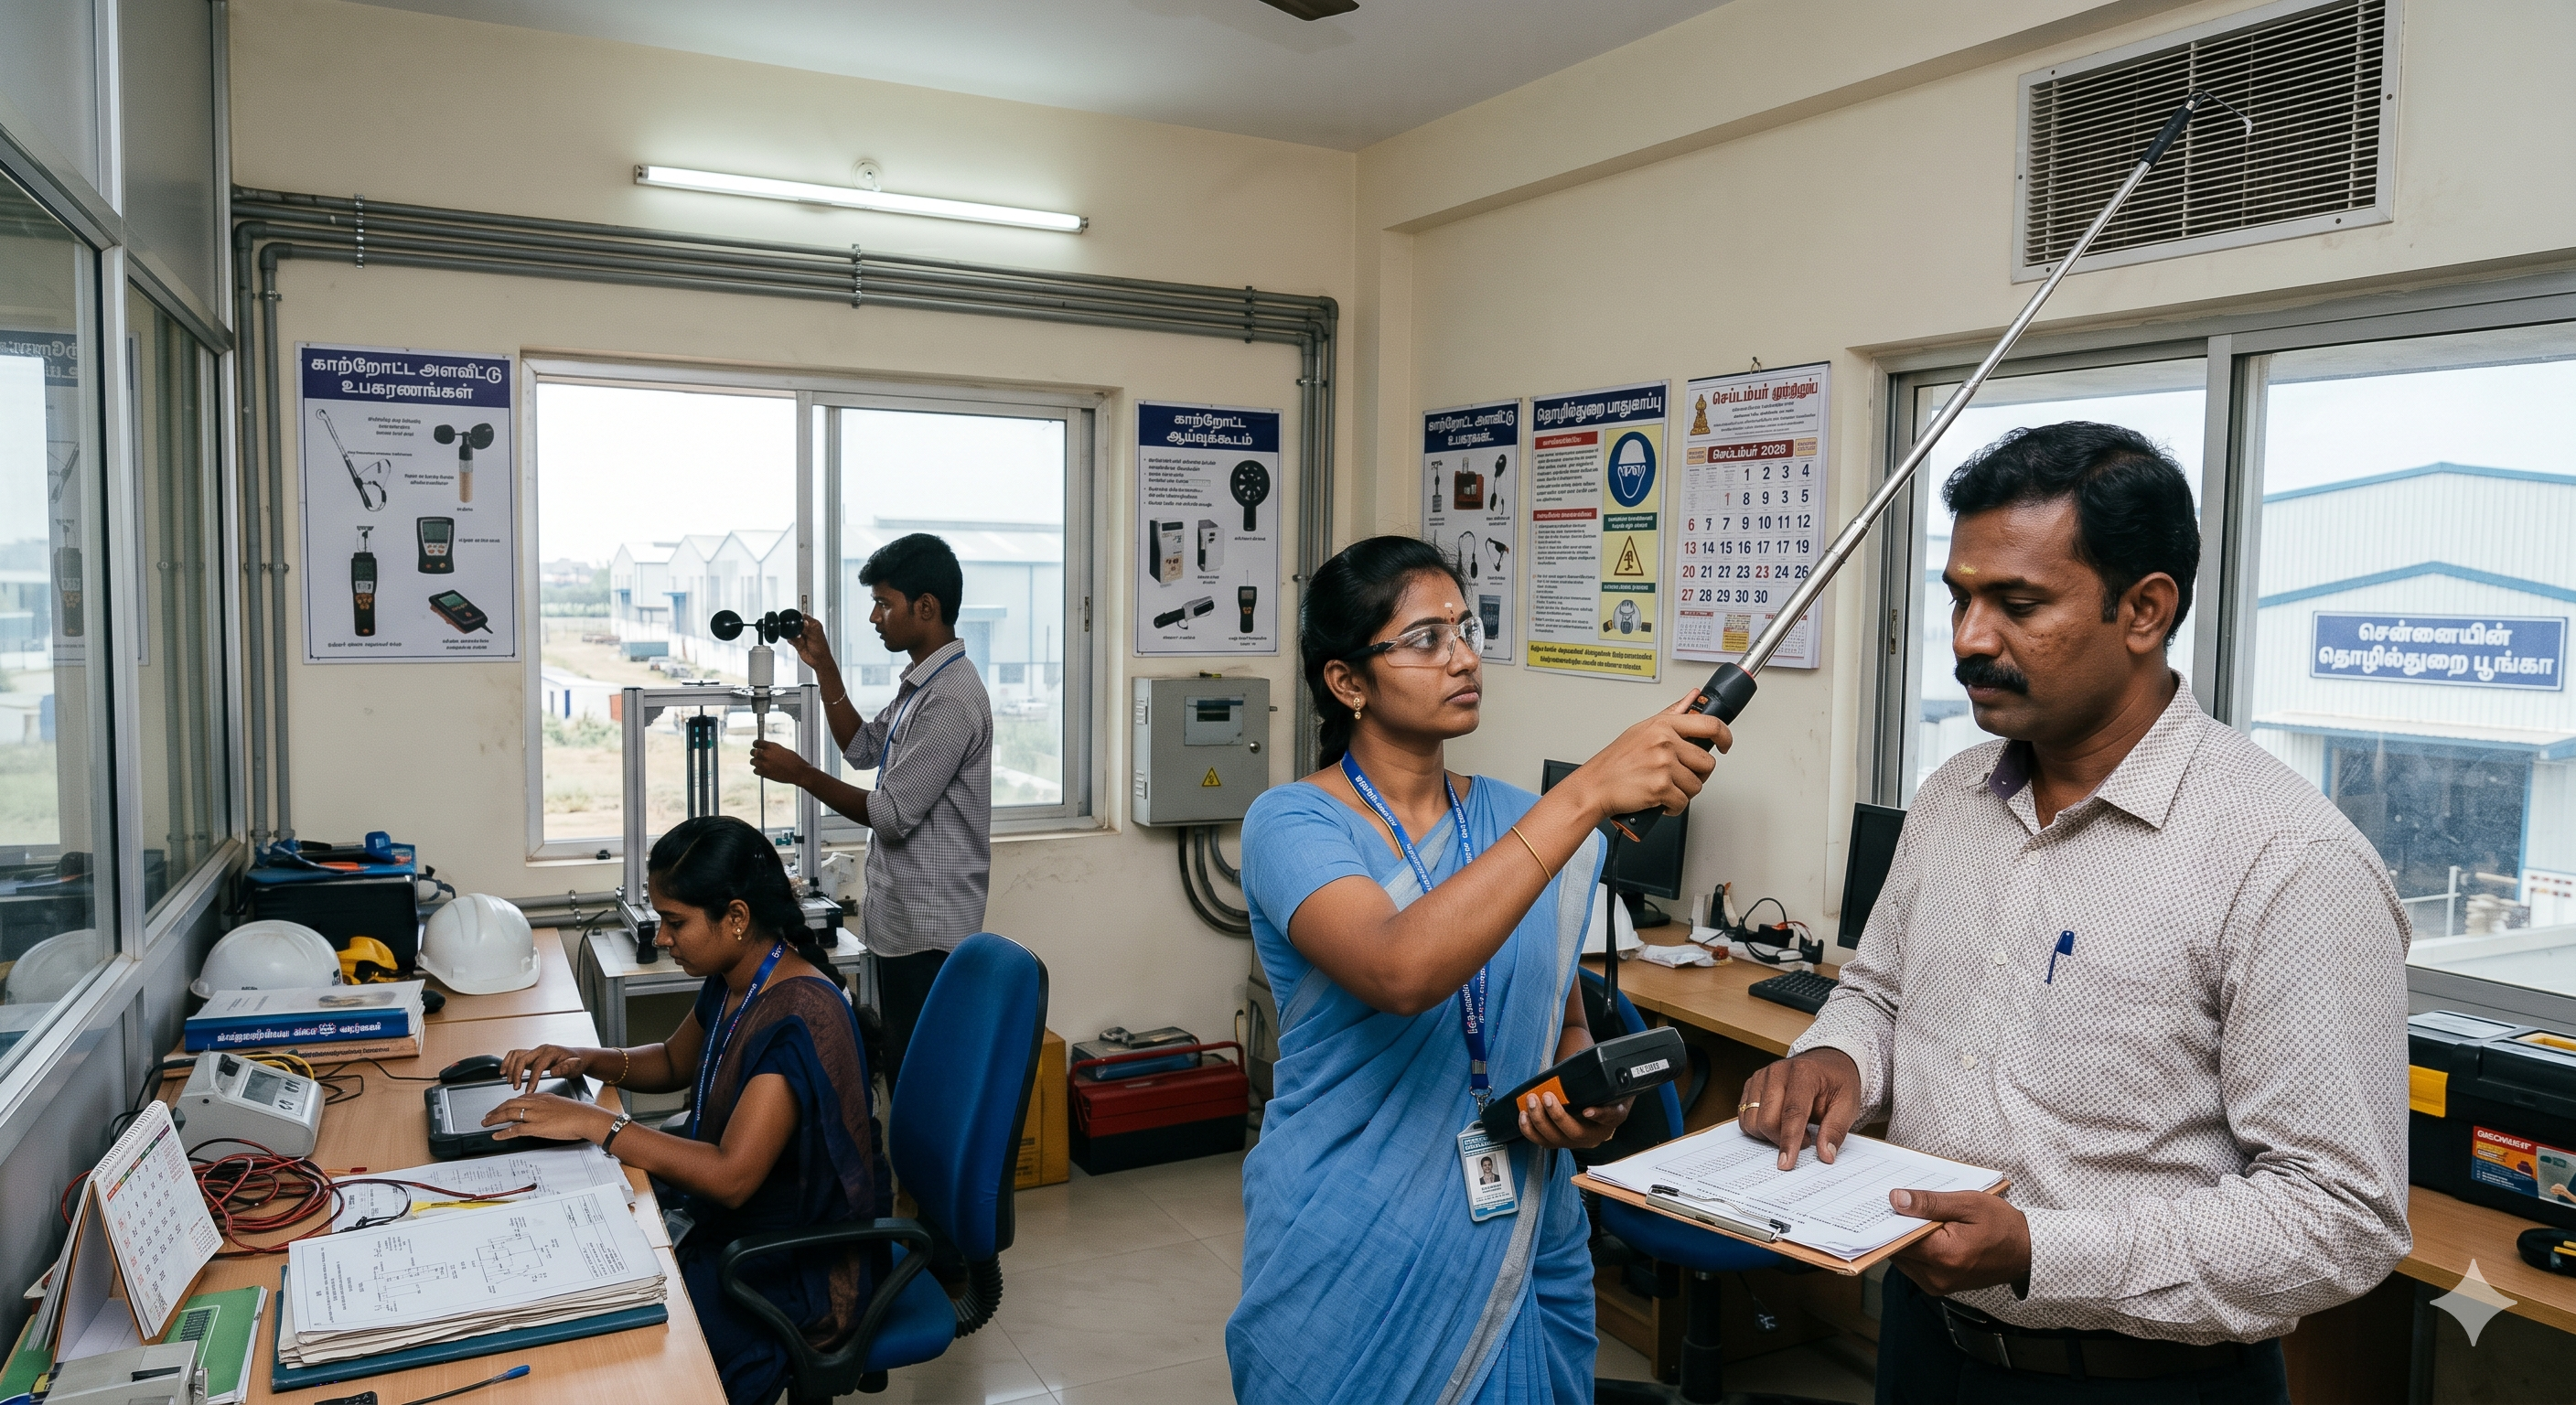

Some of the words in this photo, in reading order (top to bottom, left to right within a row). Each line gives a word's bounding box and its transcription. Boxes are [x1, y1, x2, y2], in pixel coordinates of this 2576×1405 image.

[311, 356, 416, 378] காற்றோட்ட
[420, 363, 502, 383] அளவீட்டு
[341, 381, 473, 399] உபகரணங்கள்
[1175, 413, 1246, 429] காற்றோட்ட
[1166, 429, 1252, 446] ஆய்வுக்கூடம்
[1745, 468, 1749, 480] 1
[1763, 467, 1769, 479] 2
[1782, 466, 1788, 478] 3
[1802, 464, 1809, 477] 4
[1744, 492, 1749, 505] 8
[1763, 491, 1768, 504] 9
[1782, 490, 1788, 503] 3
[1802, 489, 1809, 502] 5
[1689, 519, 1694, 531] 6
[1723, 518, 1730, 530] 7
[1743, 517, 1749, 530] 9
[1759, 516, 1771, 529] 10
[1778, 516, 1789, 529] 11
[1798, 515, 1809, 528] 12
[1685, 542, 1696, 553] 13
[1703, 542, 1714, 553] 14
[1721, 542, 1732, 553] 15
[1739, 541, 1750, 553] 16
[1757, 541, 1769, 553] 17
[1777, 541, 1789, 553] 17
[1797, 540, 1809, 553] 19
[1683, 565, 1695, 577] 20
[1701, 566, 1712, 577] 21
[1736, 565, 1749, 578] 23
[1755, 566, 1768, 578] 23
[1776, 565, 1788, 578] 24
[1682, 589, 1693, 601] 27
[1700, 589, 1712, 601] 28
[1717, 590, 1730, 602] 29
[1735, 590, 1748, 603] 30
[1755, 590, 1767, 603] 30
[2358, 619, 2513, 646] சென்னையின்
[2319, 645, 2468, 677] தொழில்துறை
[2474, 649, 2554, 681] பூங்கா
